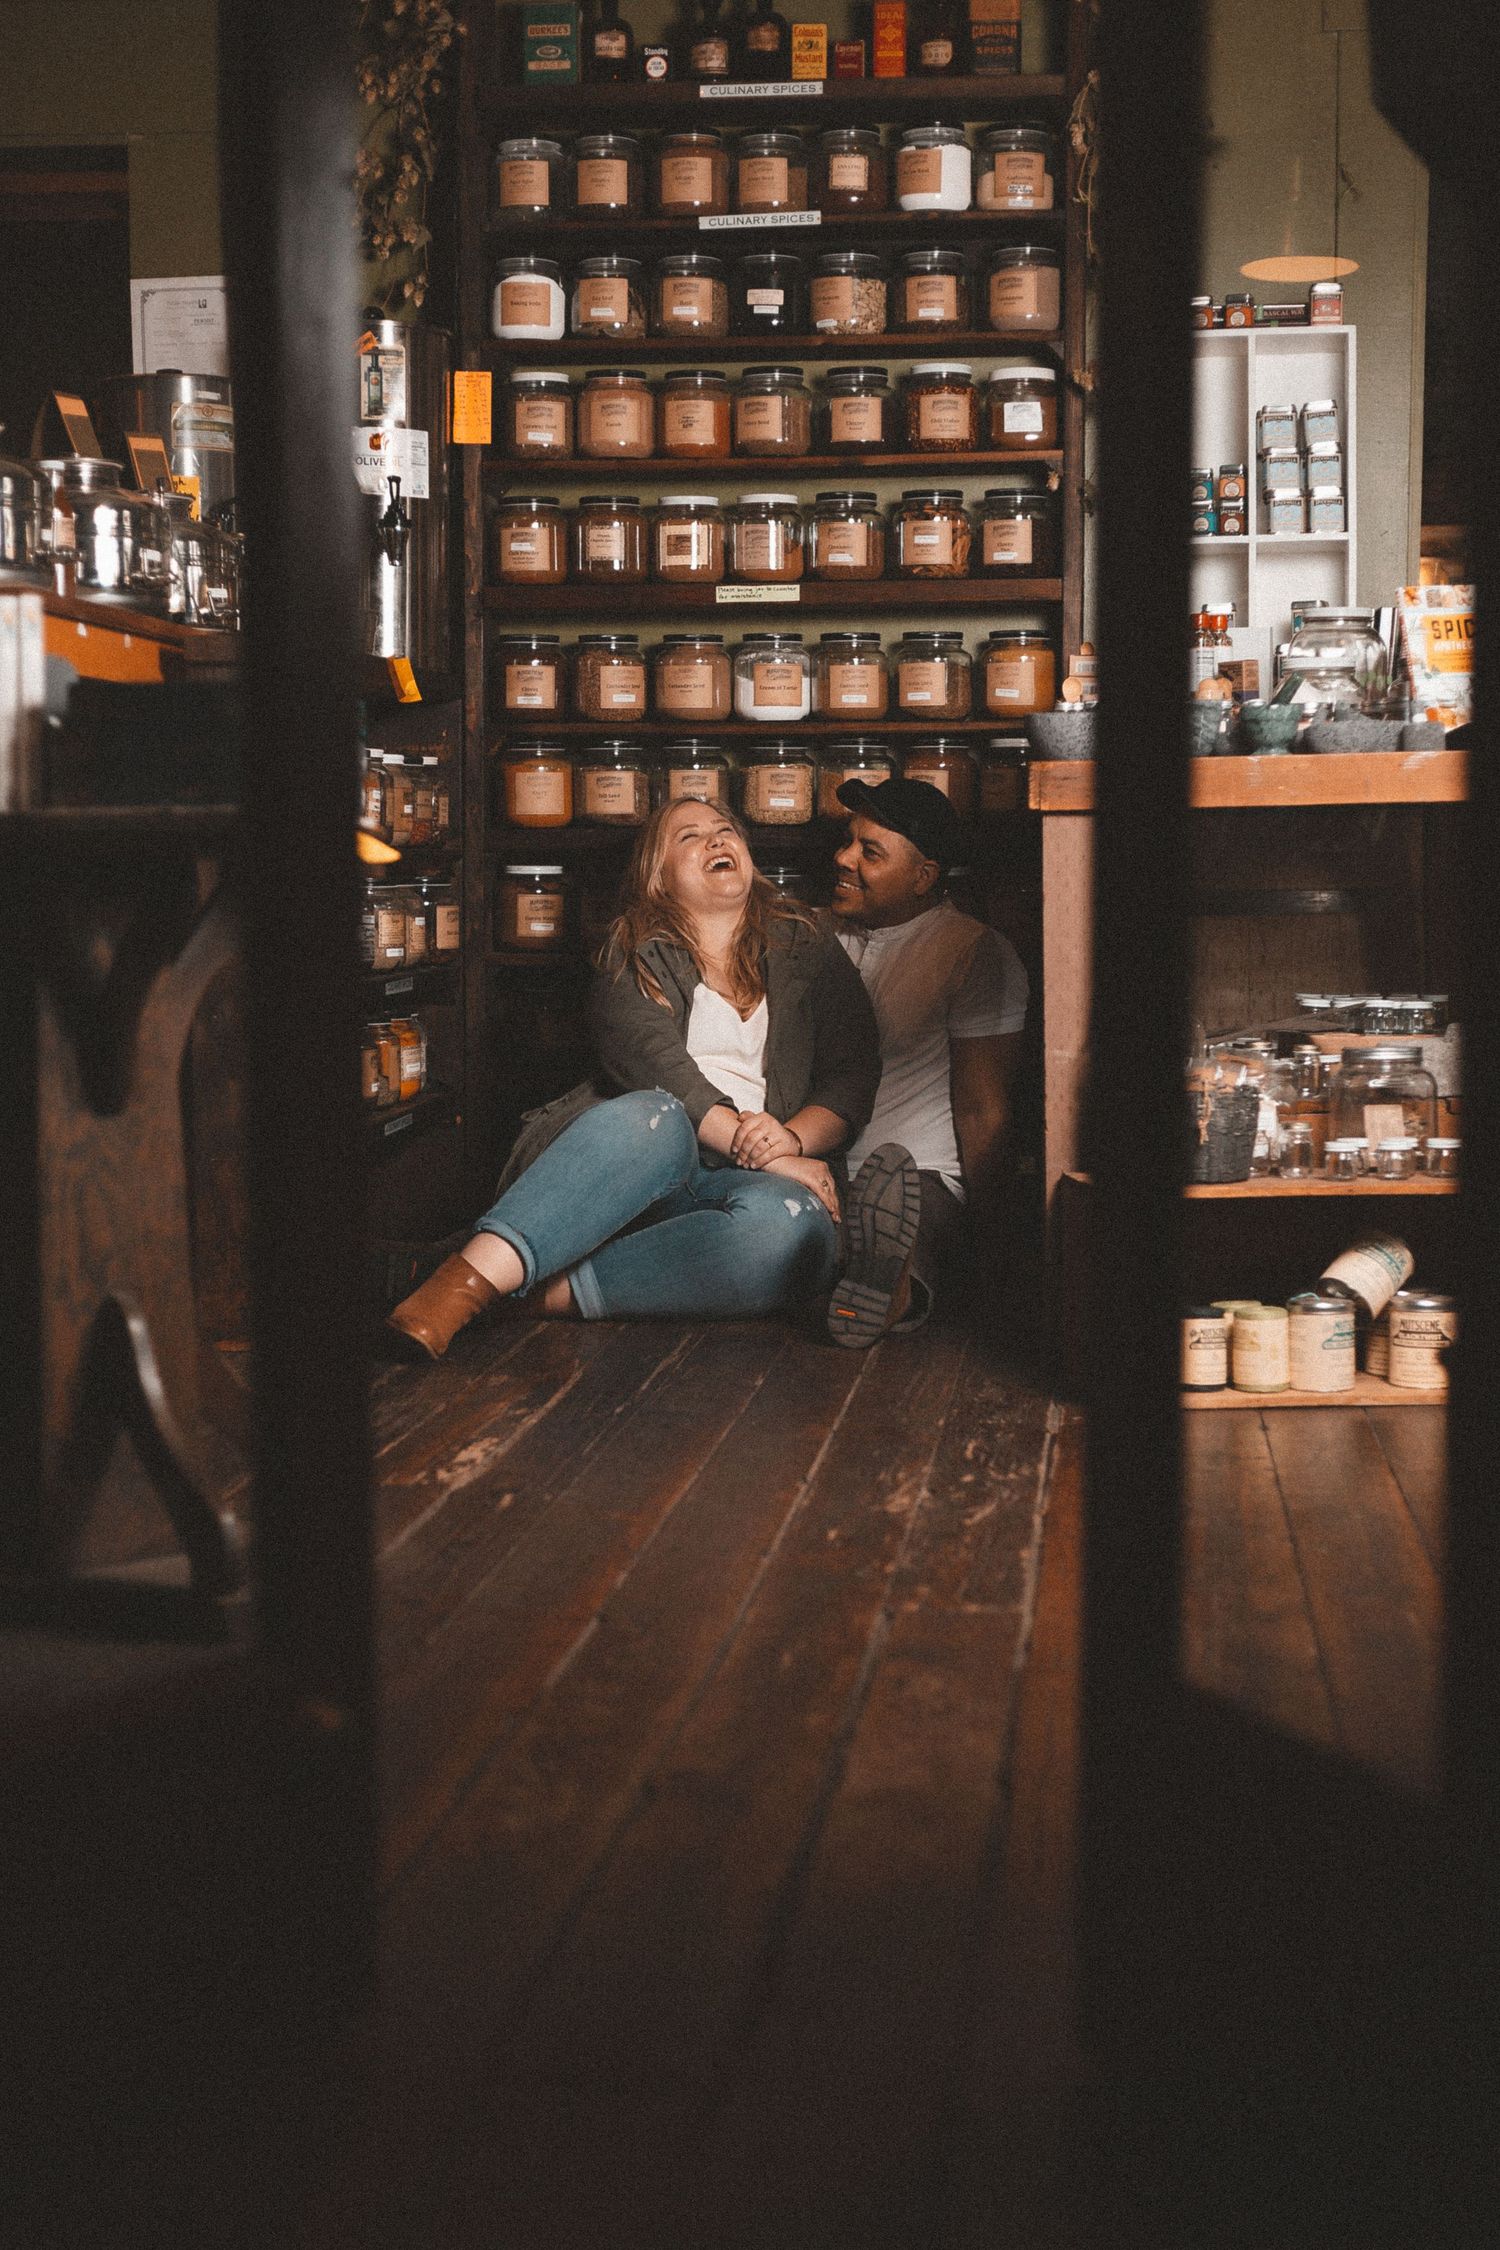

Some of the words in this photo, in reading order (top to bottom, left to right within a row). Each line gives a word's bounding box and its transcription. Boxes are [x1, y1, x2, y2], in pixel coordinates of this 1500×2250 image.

[709, 85, 769, 96] CULINARY
[772, 84, 816, 94] SPICES
[708, 215, 768, 226] CULINARY
[771, 214, 814, 224] SPICES
[355, 457, 386, 466] OLIVE
[1400, 1319, 1440, 1331] NUTSCENE
